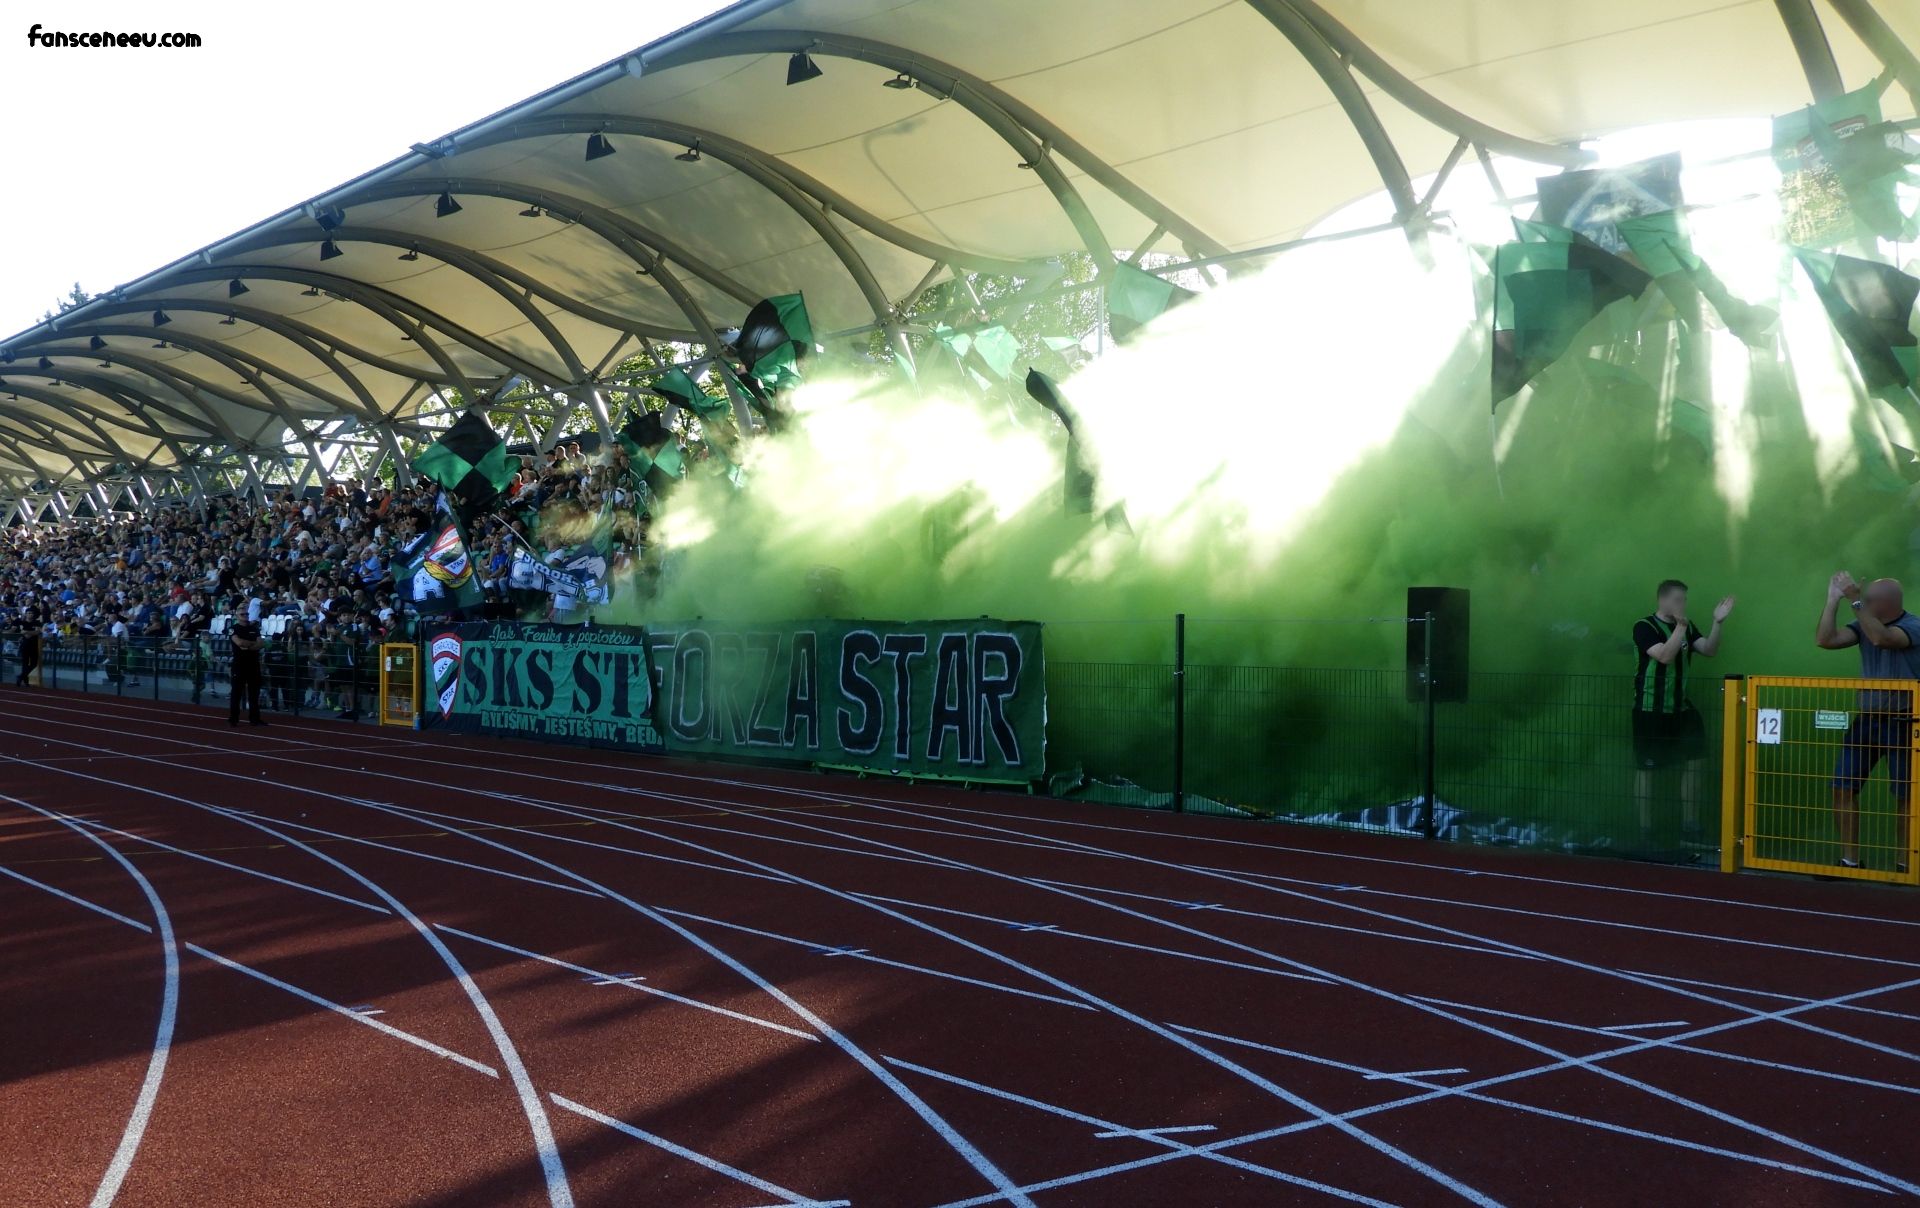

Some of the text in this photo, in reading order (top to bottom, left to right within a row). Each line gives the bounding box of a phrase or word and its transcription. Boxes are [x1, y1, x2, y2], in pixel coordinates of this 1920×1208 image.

[488, 624, 516, 649] Jak
[521, 624, 562, 644] Feniks
[442, 687, 455, 704] STAR
[463, 646, 655, 719] SKS ST
[836, 629, 1022, 765] STAR
[544, 716, 618, 743] JESTEŚMY,
[1760, 717, 1778, 735] 12
